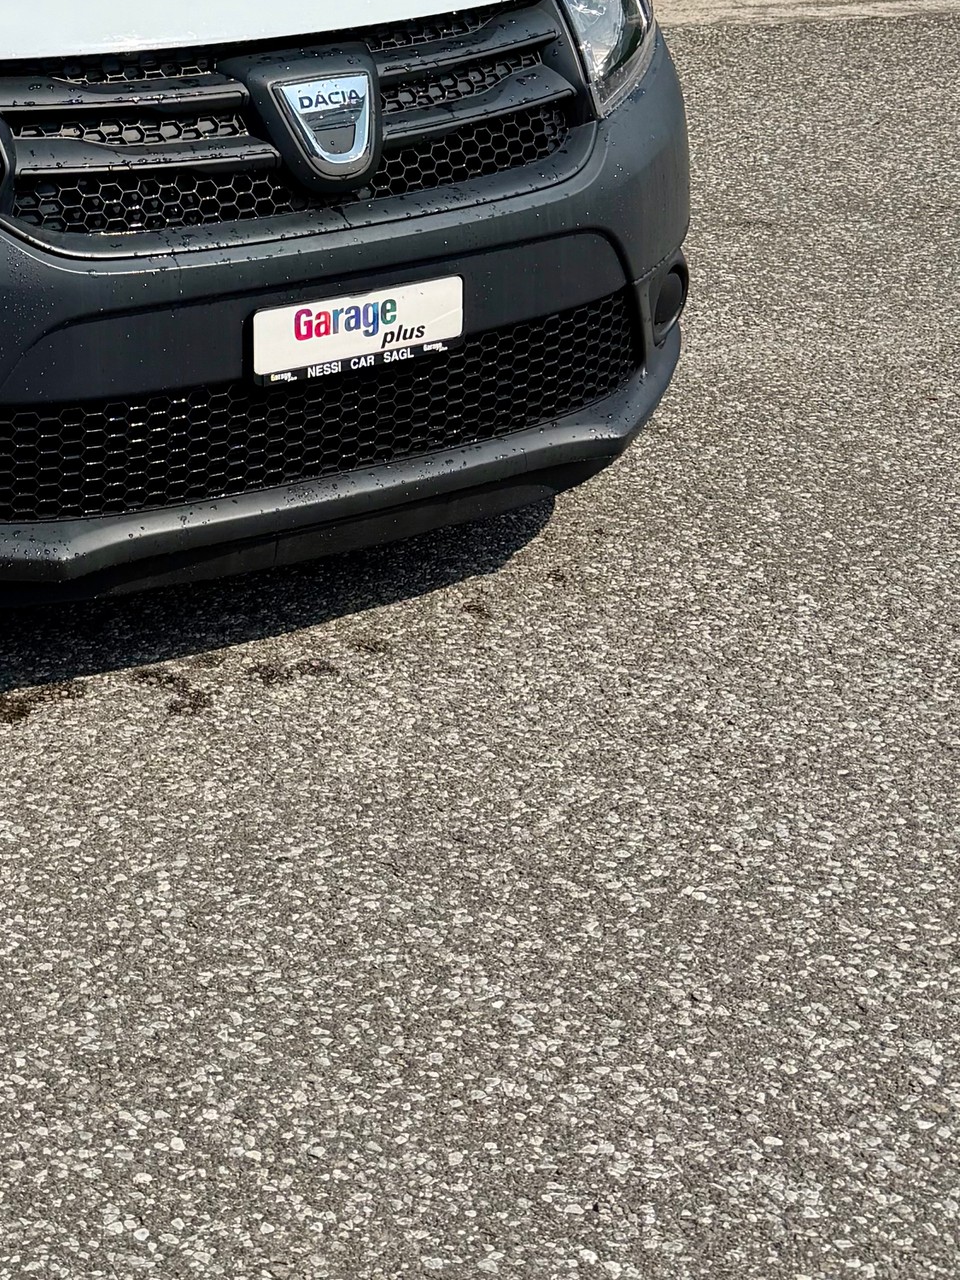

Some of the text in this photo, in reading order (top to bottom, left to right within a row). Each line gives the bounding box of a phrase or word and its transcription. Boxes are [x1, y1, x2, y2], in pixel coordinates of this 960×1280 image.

[298, 89, 364, 109] DACIA
[294, 297, 398, 341] Garage
[380, 324, 426, 349] plus
[307, 347, 415, 378] NESSI CAR SAGL
